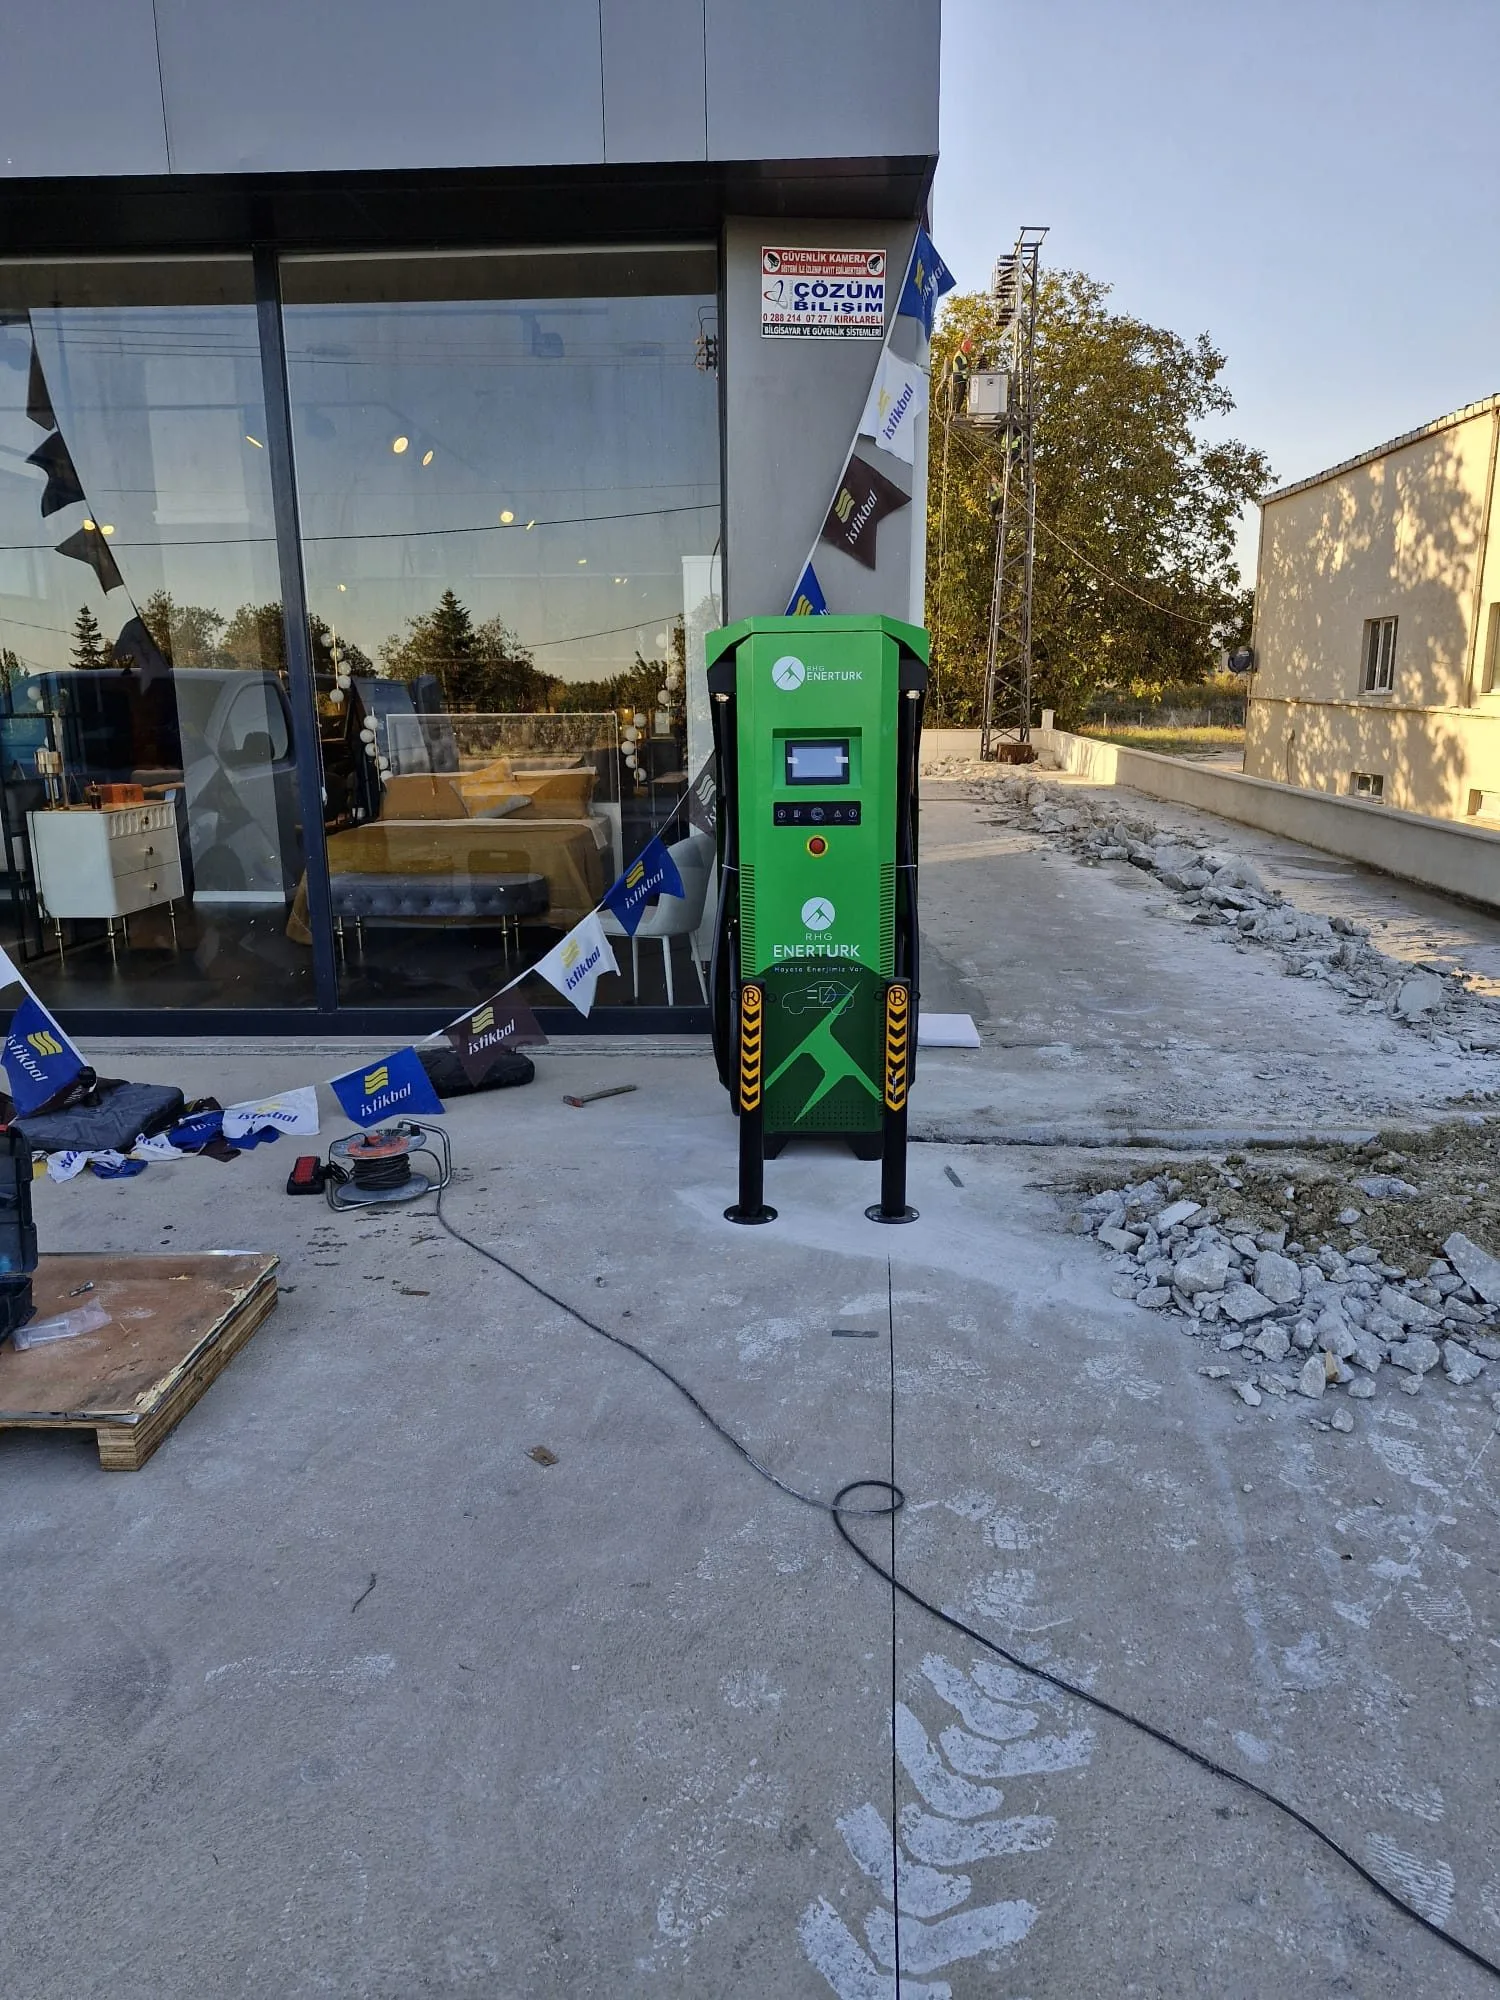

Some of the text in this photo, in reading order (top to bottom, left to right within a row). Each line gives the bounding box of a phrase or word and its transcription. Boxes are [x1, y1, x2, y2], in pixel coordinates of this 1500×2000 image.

[782, 250, 866, 263] GÜVENLİK KAMERA
[794, 279, 884, 302] ÇÖZÜM
[763, 313, 768, 322] 0
[770, 313, 785, 322] 288
[787, 313, 801, 323] 214
[806, 314, 815, 323] 07
[818, 315, 828, 323] 27
[834, 314, 883, 324] KIRKLARELİ
[764, 324, 882, 337] BİLGİSAYAR VE GÜVENLİK SİSTEMLERİ
[884, 383, 914, 441] istikbal
[845, 487, 879, 546] istikbal
[624, 868, 665, 911] istikbal
[805, 932, 833, 941] RHG
[566, 945, 602, 992] istikbal
[467, 1017, 517, 1056] istikbal
[6, 1033, 49, 1083] istikbal
[360, 1082, 413, 1118] istikbal
